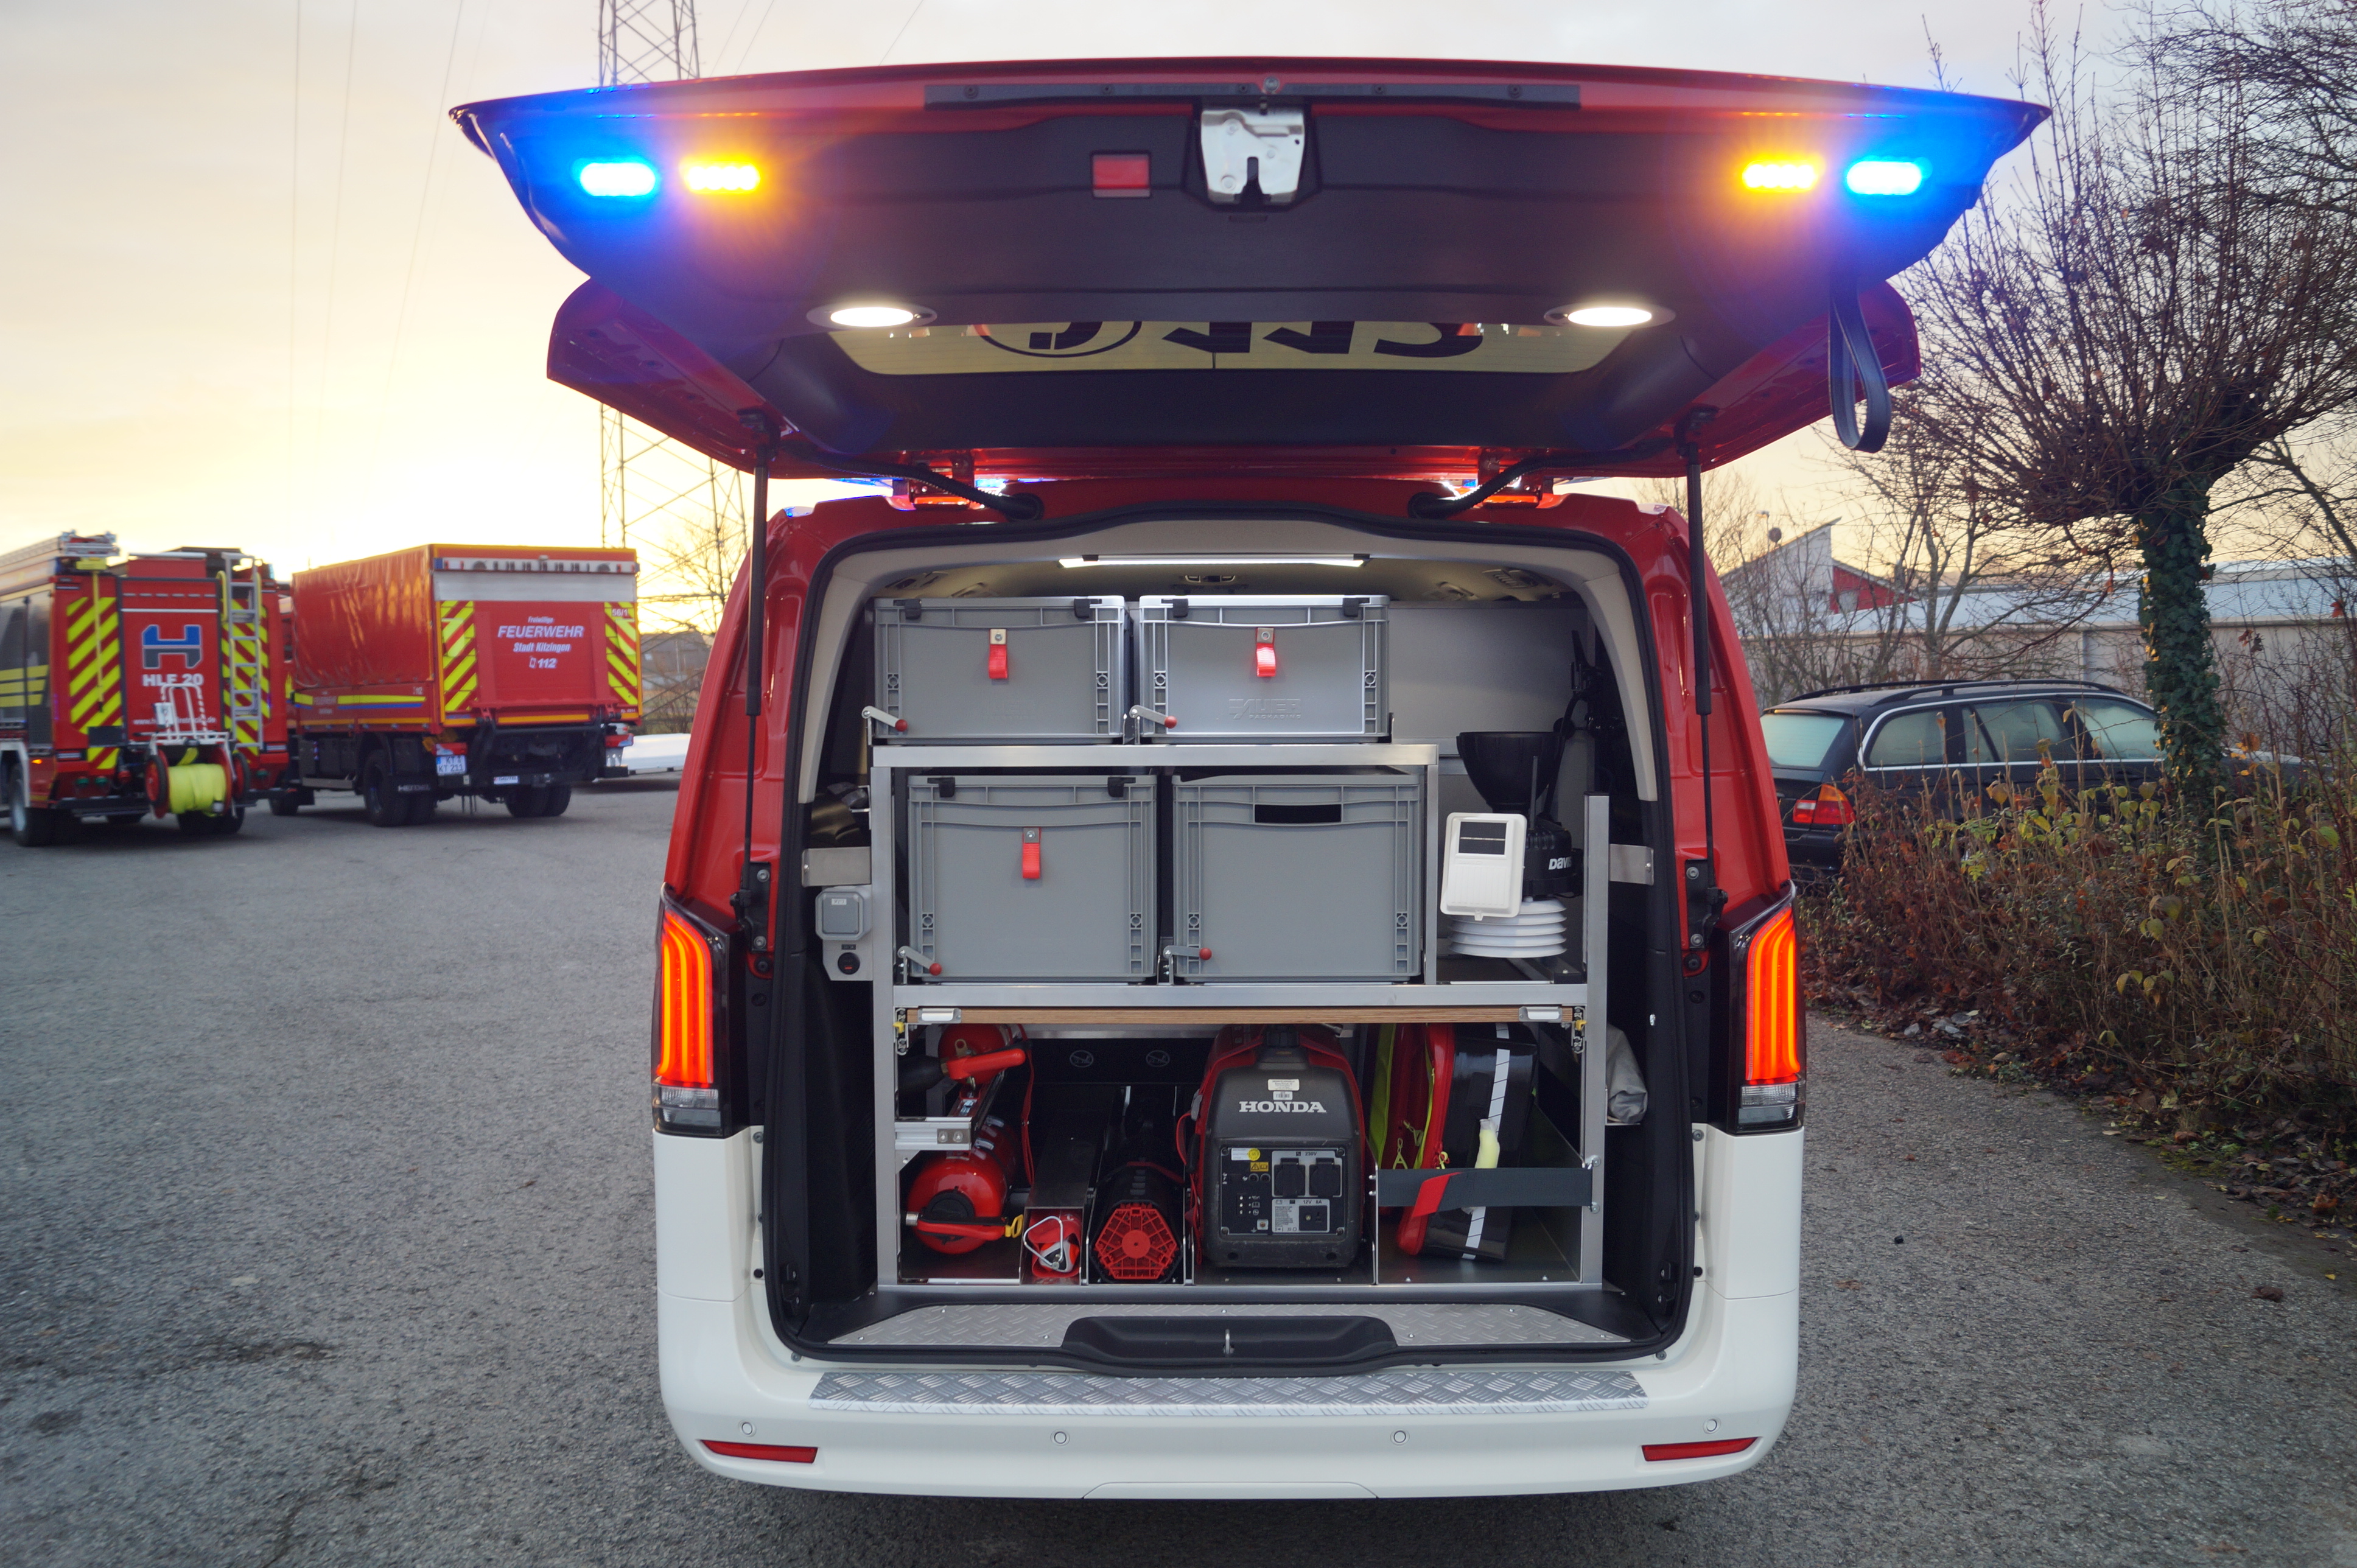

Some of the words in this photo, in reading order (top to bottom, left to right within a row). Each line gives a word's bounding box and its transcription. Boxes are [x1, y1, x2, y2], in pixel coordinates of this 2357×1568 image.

[497, 625, 584, 638] FEUERWEHR
[513, 642, 534, 653] Stadt
[536, 642, 571, 653] Kitzingen
[538, 658, 558, 668] 112
[182, 673, 204, 687] 20
[1239, 1101, 1327, 1113] HONDA
